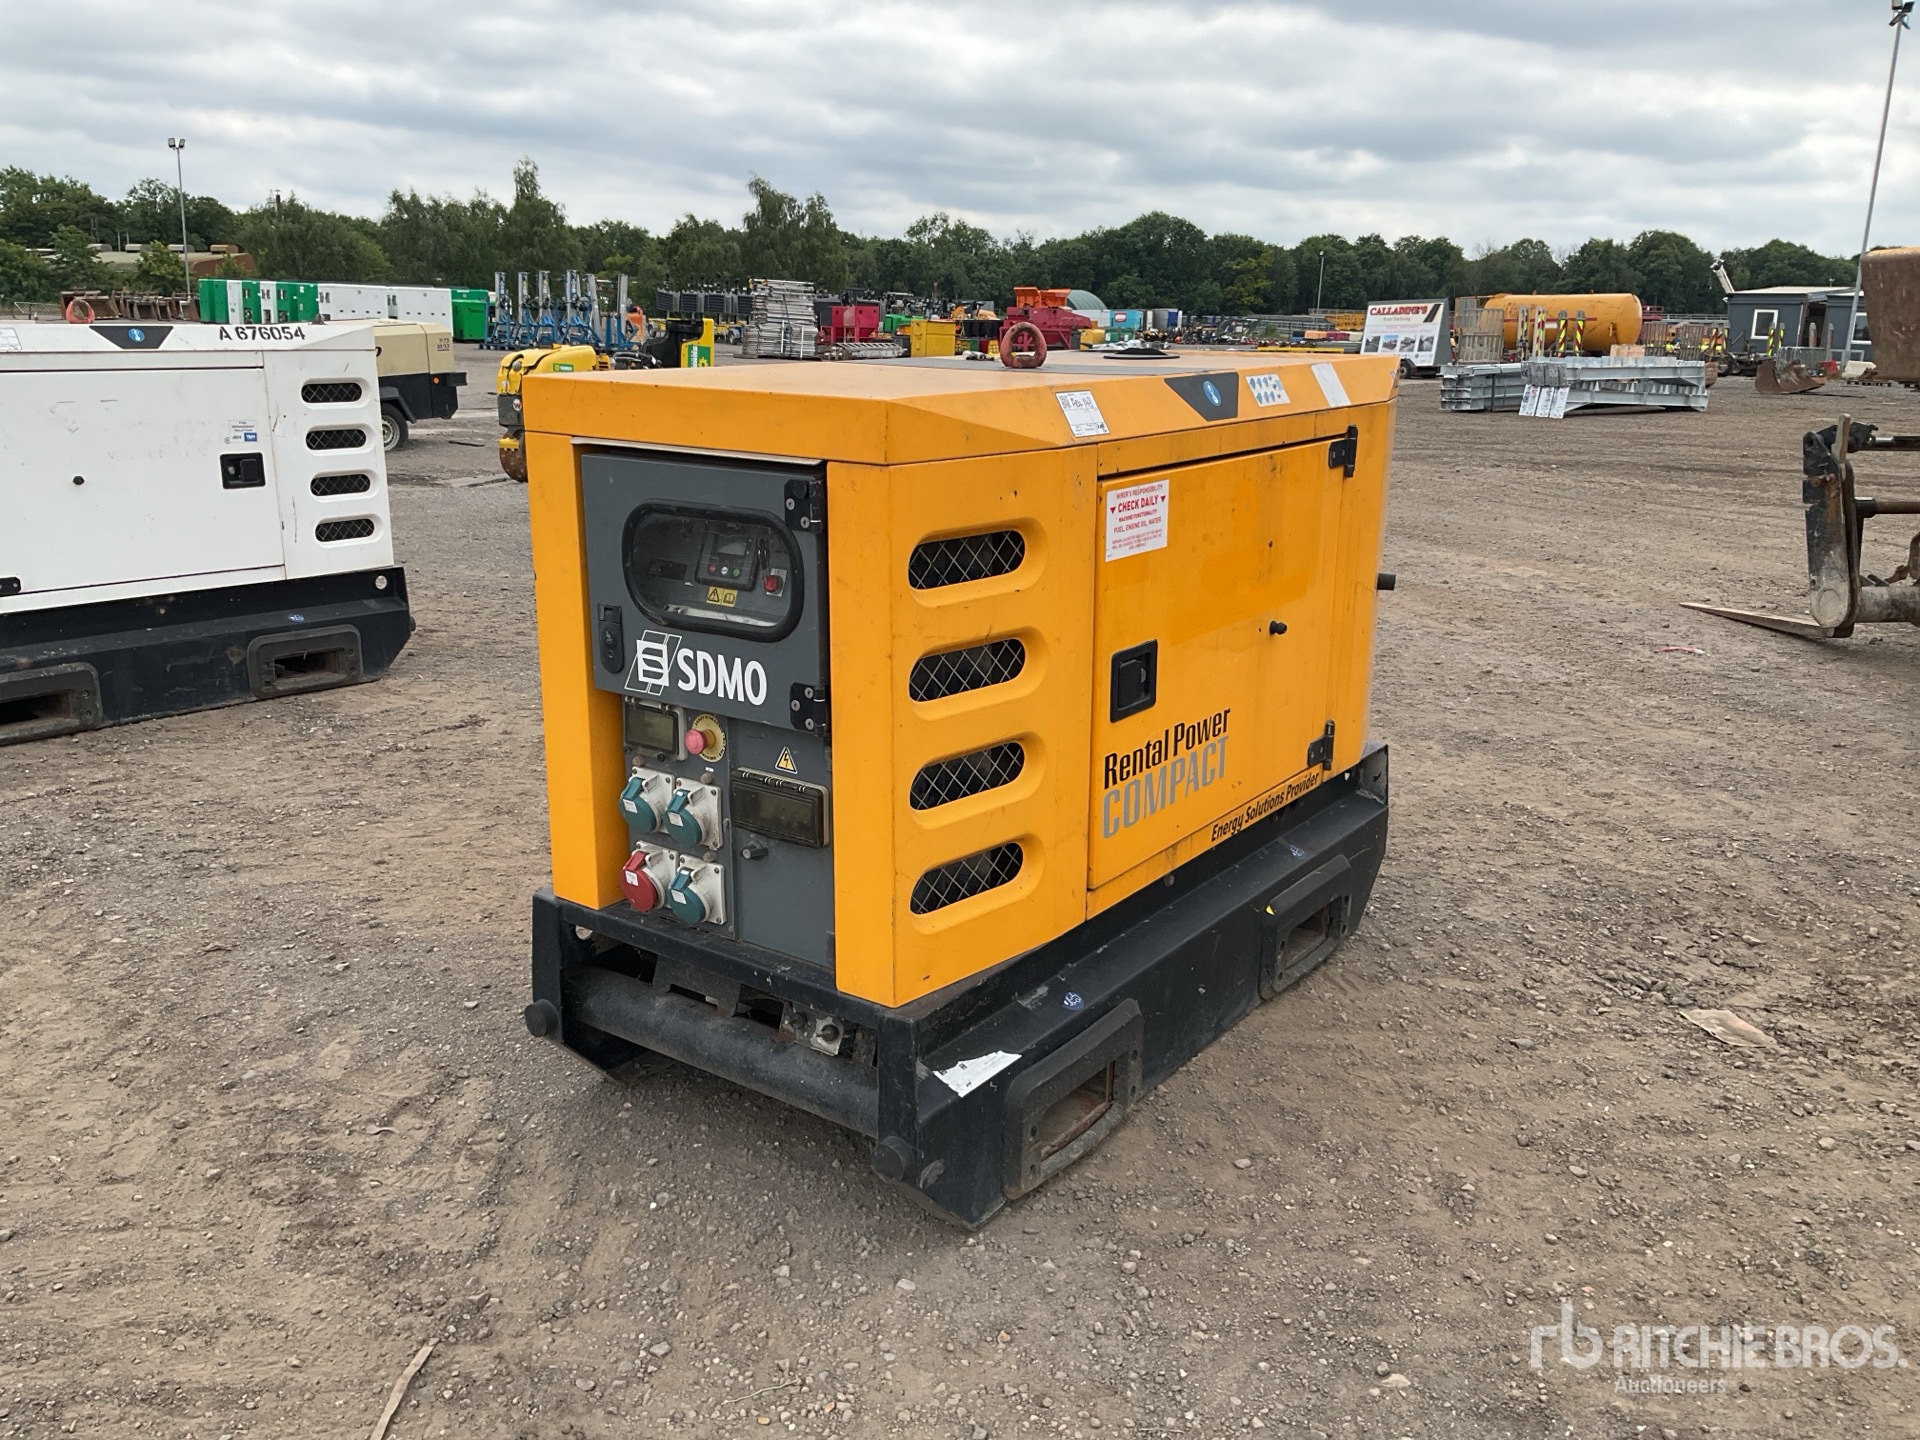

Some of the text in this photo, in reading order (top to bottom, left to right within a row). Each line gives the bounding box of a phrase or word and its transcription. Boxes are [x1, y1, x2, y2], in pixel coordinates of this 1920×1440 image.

[219, 325, 306, 341] A 676054
[1132, 484, 1163, 496] RESPONSIBILITY
[1117, 494, 1159, 513] CHECK DAILY
[1118, 514, 1133, 522] MACHINE
[1125, 521, 1140, 531] ENGINE
[1148, 516, 1162, 525] WATER
[676, 648, 767, 706] SDMO
[1104, 708, 1231, 790] Rental Power
[1102, 735, 1230, 839] COMPACT
[1210, 771, 1320, 843] Energy Solutions Provider
